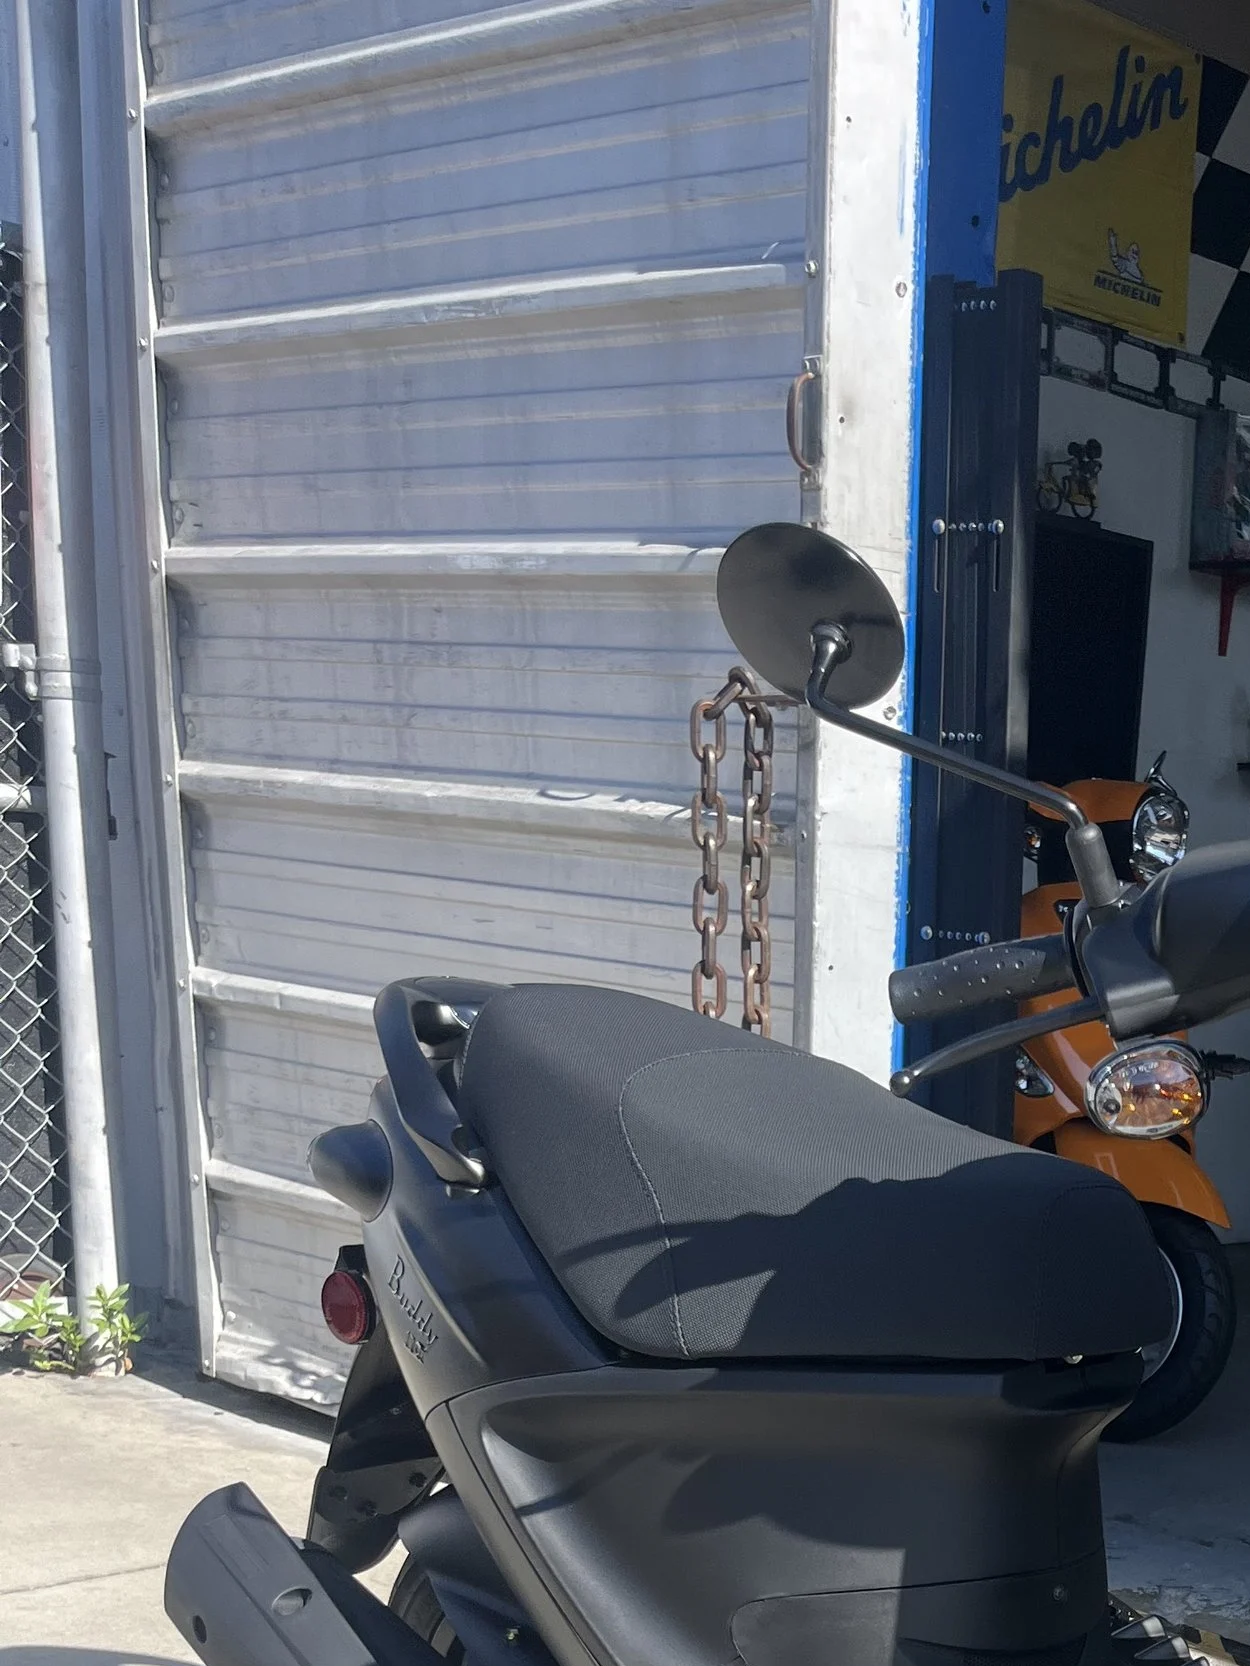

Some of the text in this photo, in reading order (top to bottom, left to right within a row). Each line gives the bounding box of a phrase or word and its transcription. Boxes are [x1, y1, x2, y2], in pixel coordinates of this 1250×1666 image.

[998, 45, 1188, 203] ichelin
[1094, 273, 1162, 307] MICHELIN
[387, 1254, 438, 1347] Buddy
